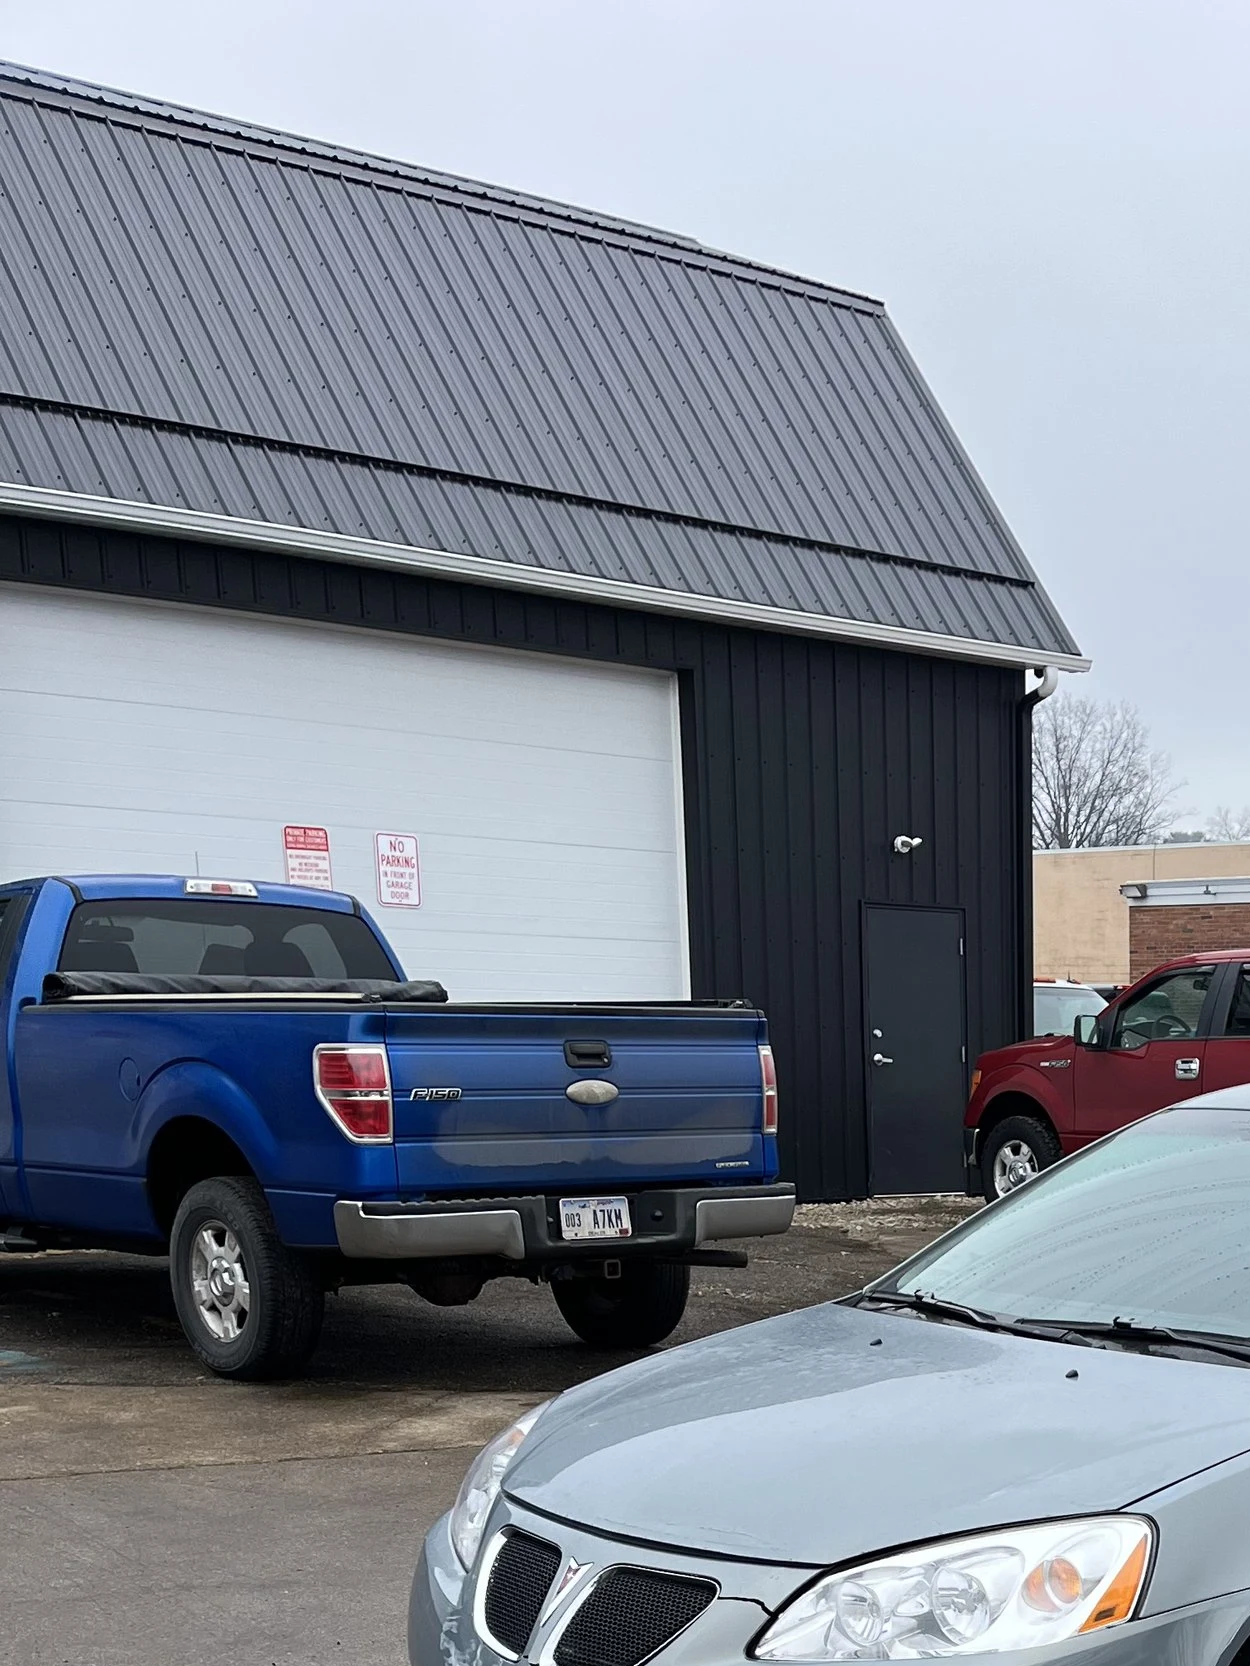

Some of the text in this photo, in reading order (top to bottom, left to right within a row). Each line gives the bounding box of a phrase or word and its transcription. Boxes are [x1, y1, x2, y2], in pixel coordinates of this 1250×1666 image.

[390, 839, 405, 853] NO
[381, 854, 415, 869] PARKING
[386, 880, 413, 890] GARAGE
[391, 890, 409, 900] DOOR
[565, 1213, 581, 1227] 003
